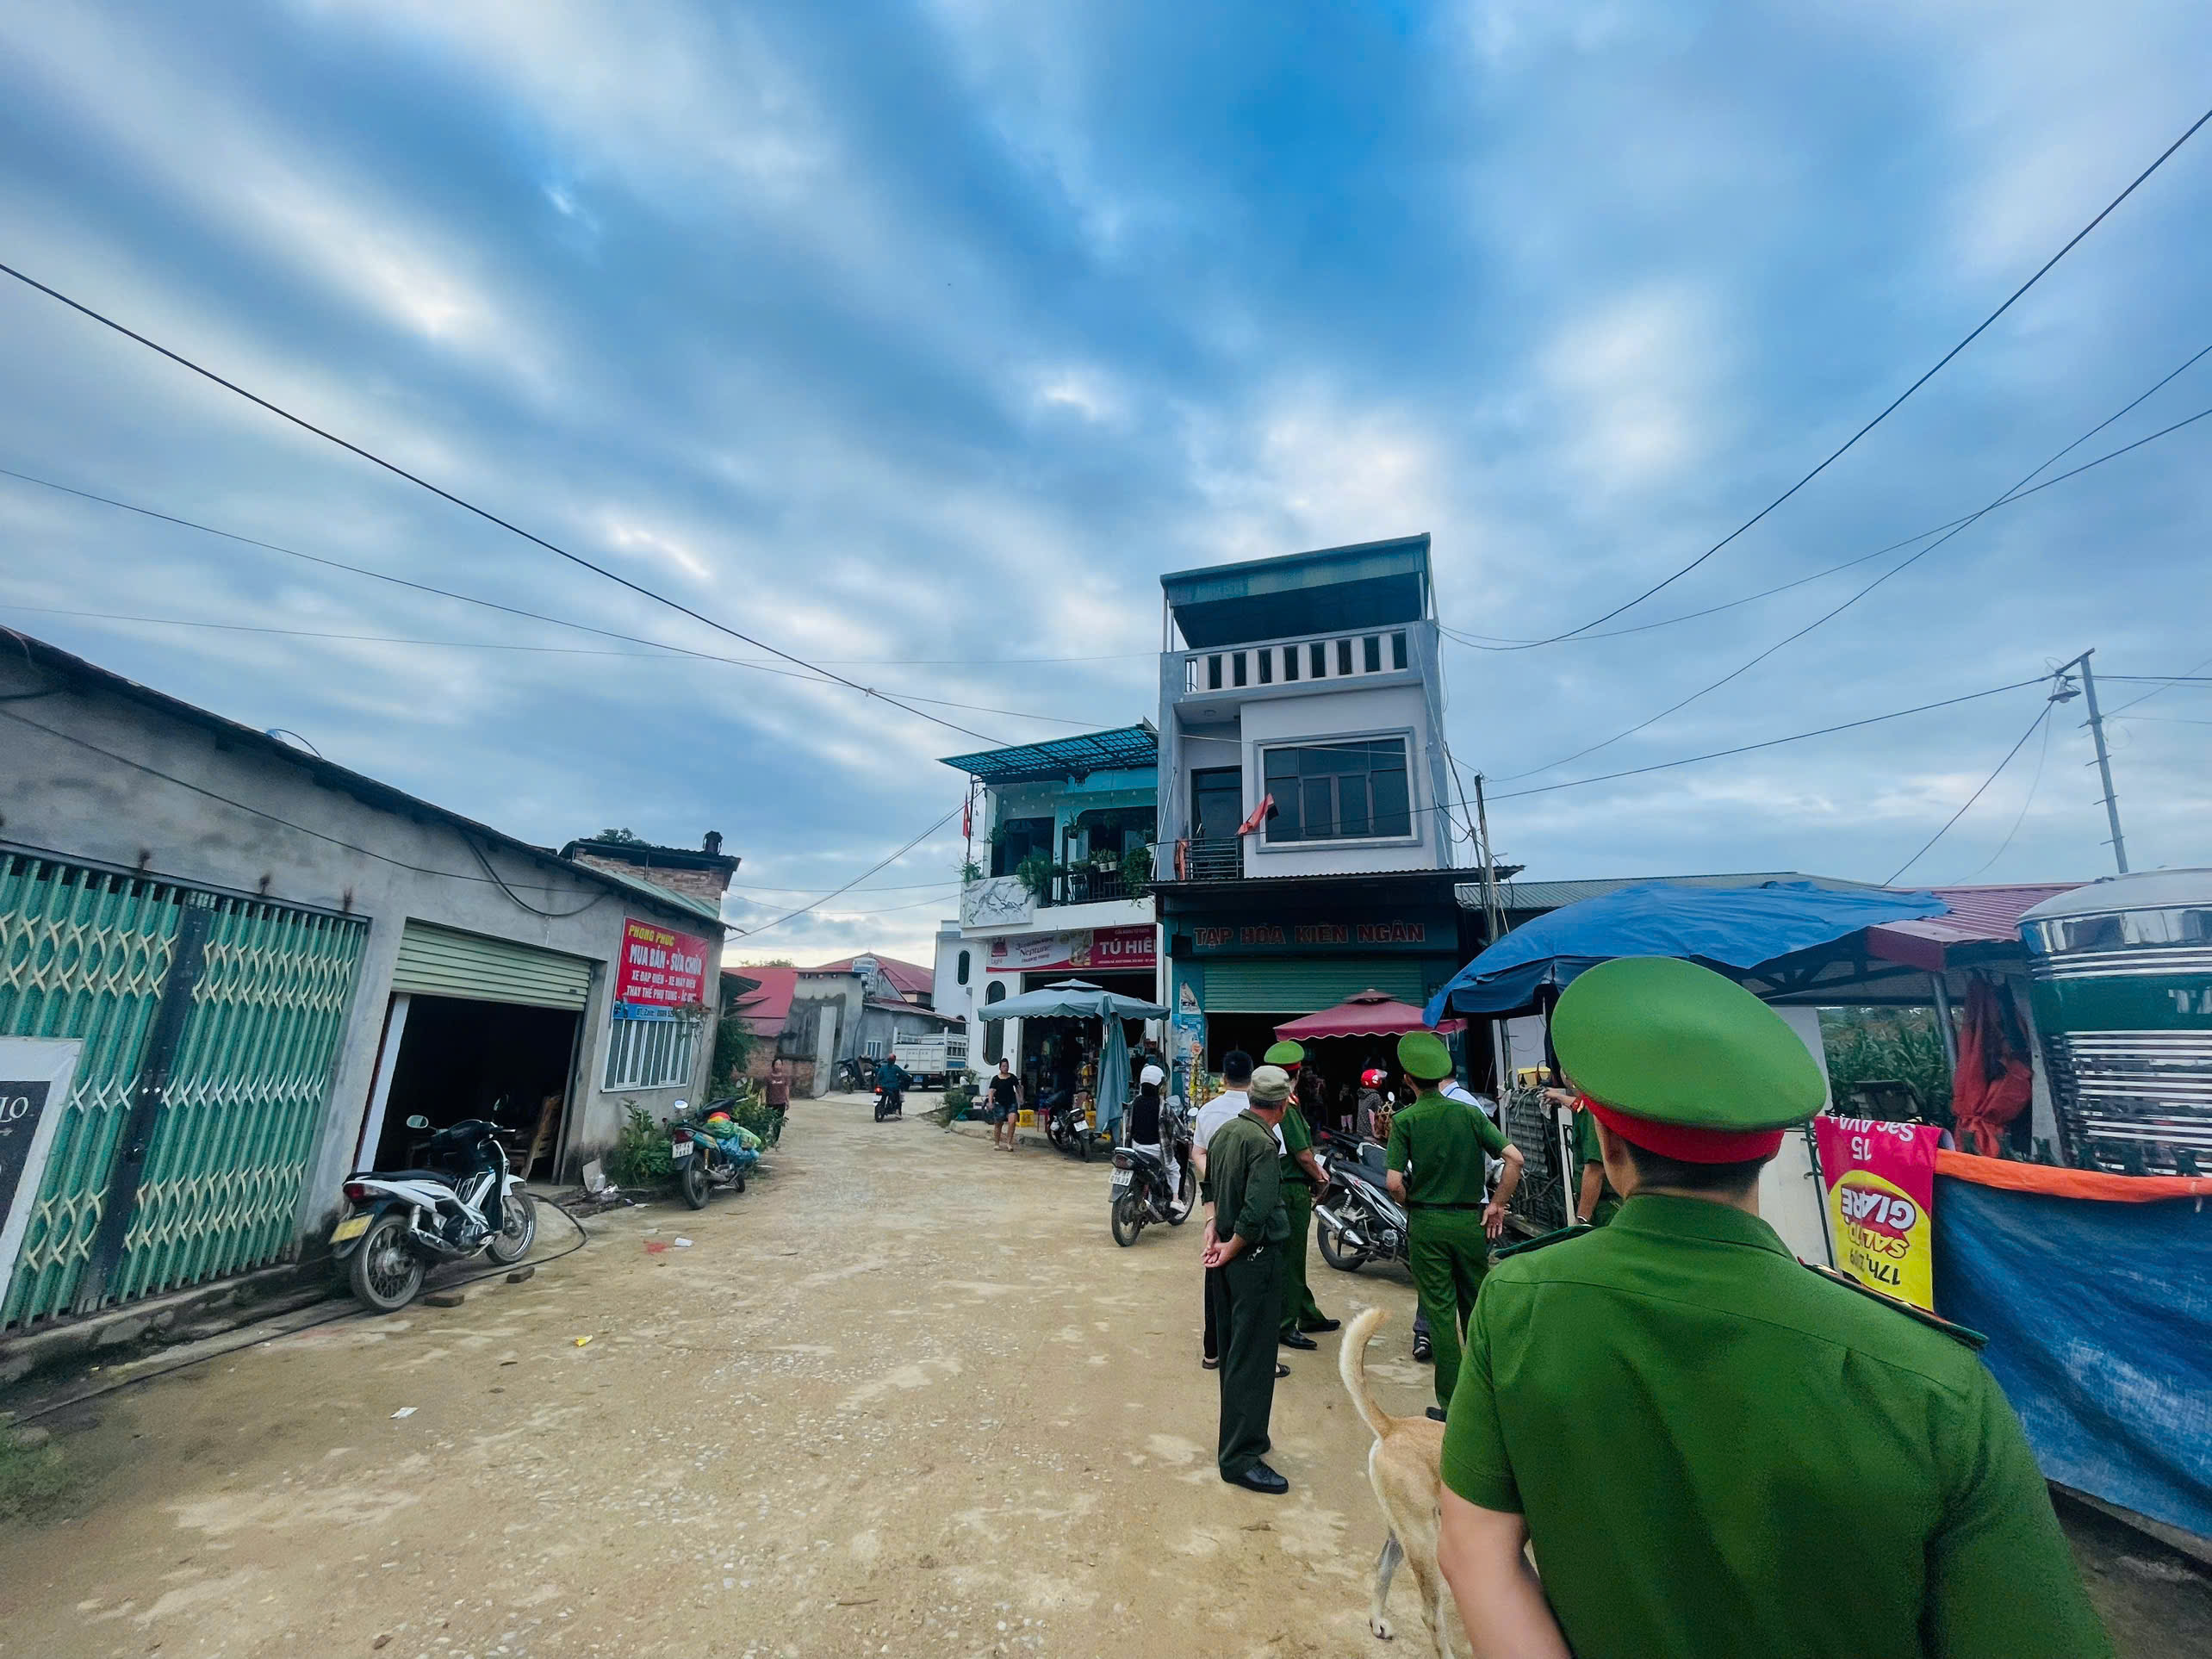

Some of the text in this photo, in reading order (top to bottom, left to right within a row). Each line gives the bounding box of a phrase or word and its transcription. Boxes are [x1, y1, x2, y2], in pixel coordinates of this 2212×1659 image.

[1099, 937, 1122, 955] TÚ
[1193, 927, 1234, 949] TẠP
[1357, 919, 1426, 943] NGÂN
[629, 943, 649, 966] MUA
[649, 944, 667, 969] BÁN
[627, 985, 642, 997] THAY
[1852, 1135, 1873, 1160] 15
